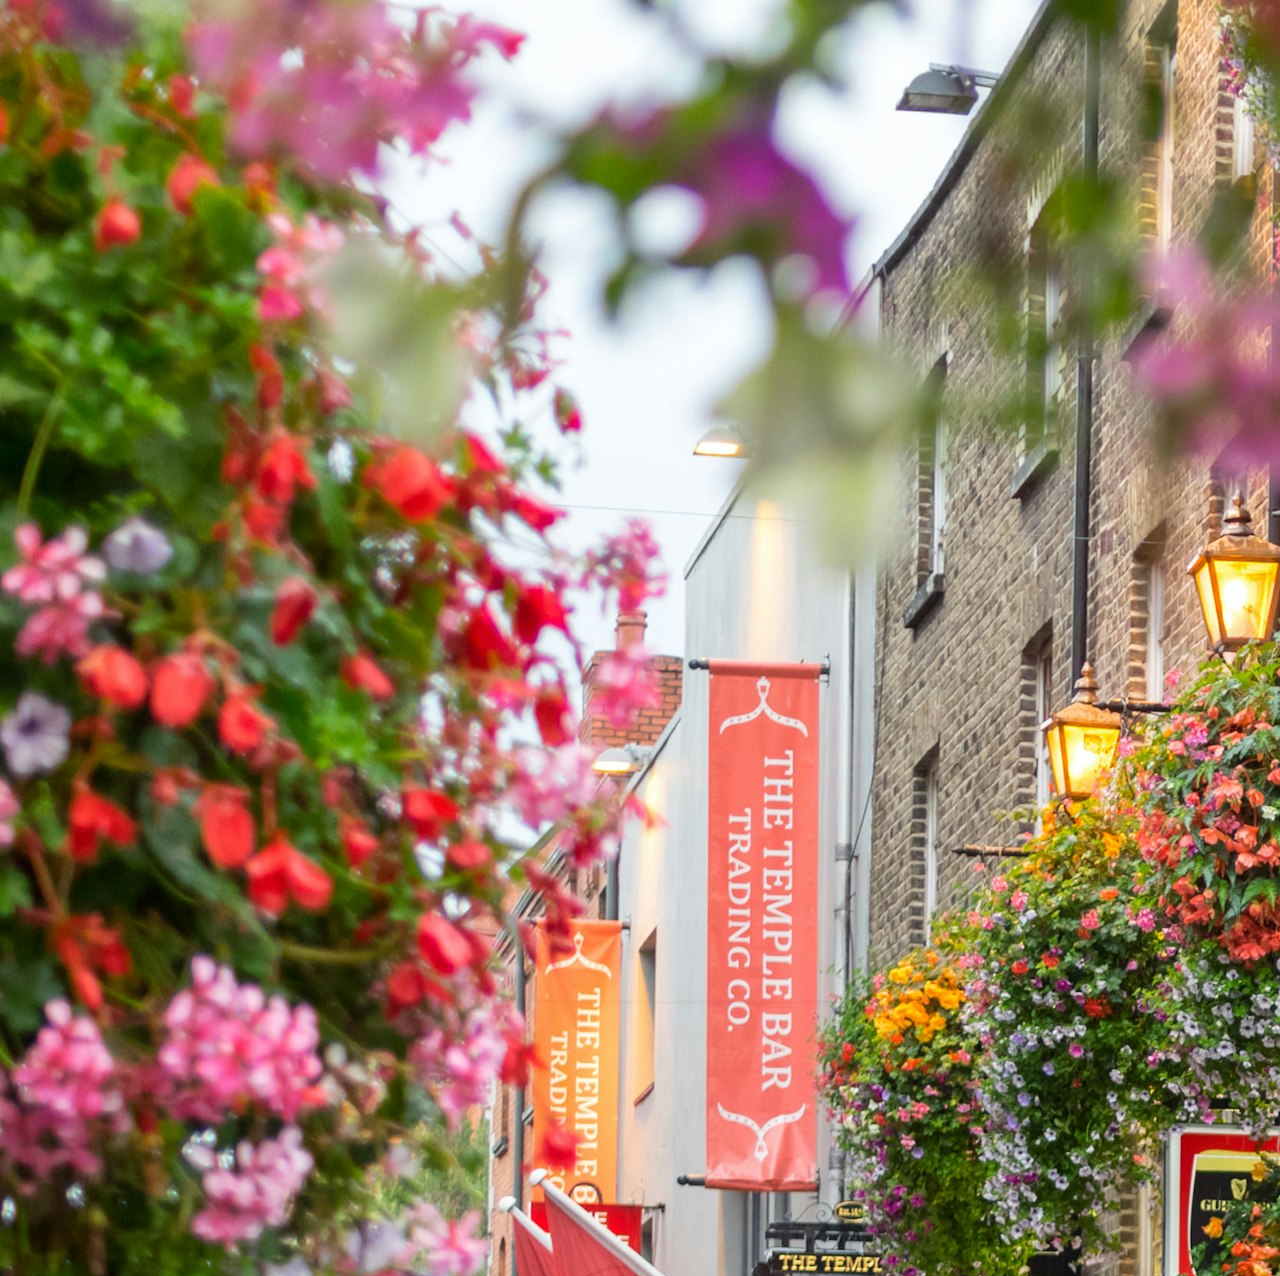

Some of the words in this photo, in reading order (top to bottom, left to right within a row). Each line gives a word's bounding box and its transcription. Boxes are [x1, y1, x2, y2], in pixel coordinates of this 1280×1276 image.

[764, 750, 794, 830] THE
[727, 808, 752, 969] TRADING
[762, 841, 794, 1000] TEMPLE
[575, 988, 601, 1048] THE
[727, 979, 751, 1032] CO.
[761, 1012, 792, 1092] BAR
[574, 1056, 600, 1177] TEMPLE
[779, 1254, 817, 1272] THE
[821, 1255, 883, 1273] TEMPL
